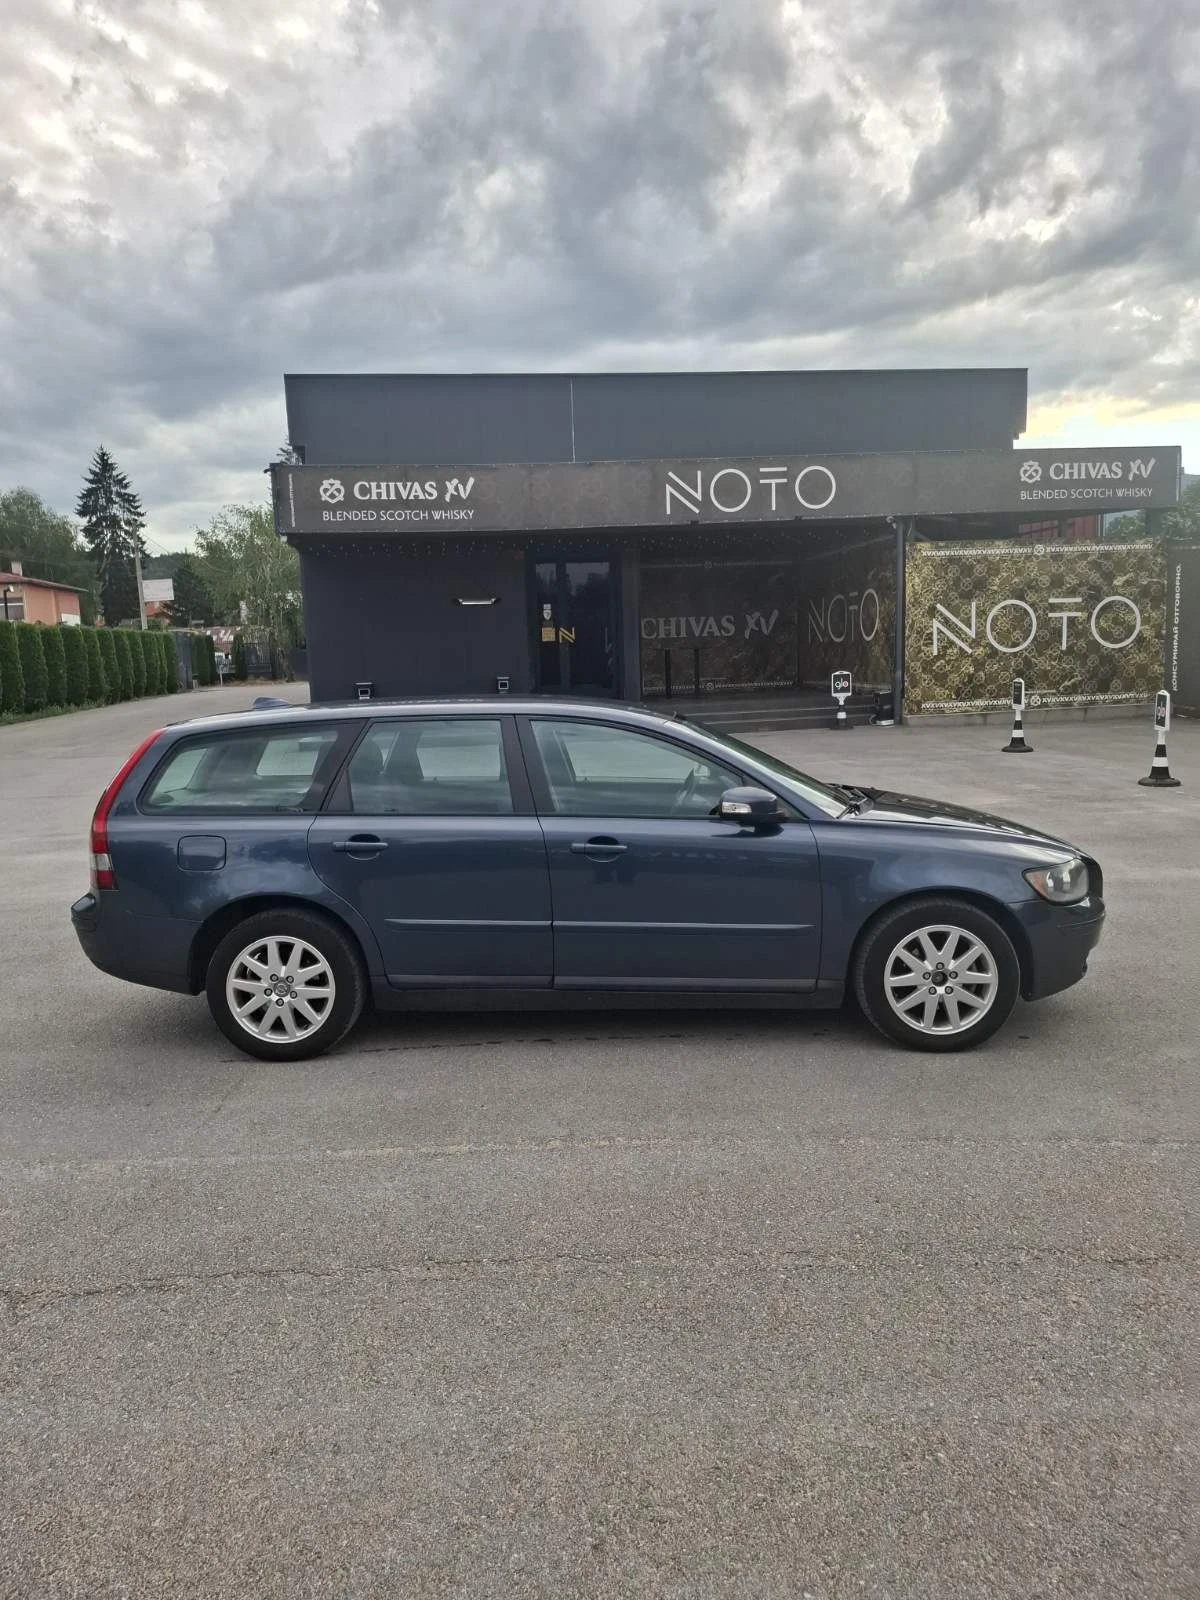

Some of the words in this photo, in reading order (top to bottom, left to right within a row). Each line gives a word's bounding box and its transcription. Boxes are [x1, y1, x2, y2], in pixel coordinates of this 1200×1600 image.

[1049, 461, 1123, 480] CHIVAS
[353, 481, 438, 500] CHIVAS
[665, 465, 837, 515] NOTO
[1020, 489, 1068, 500] BLENDED
[1070, 487, 1113, 499] SCOTCH
[1115, 487, 1153, 498] WHISKY
[322, 510, 377, 521] BLENDED
[380, 510, 429, 521] SCOTCH
[431, 509, 475, 520] WHISKY
[808, 588, 880, 643] NOTO
[933, 595, 1141, 656] NOTO
[640, 615, 736, 639] CHIVAS
